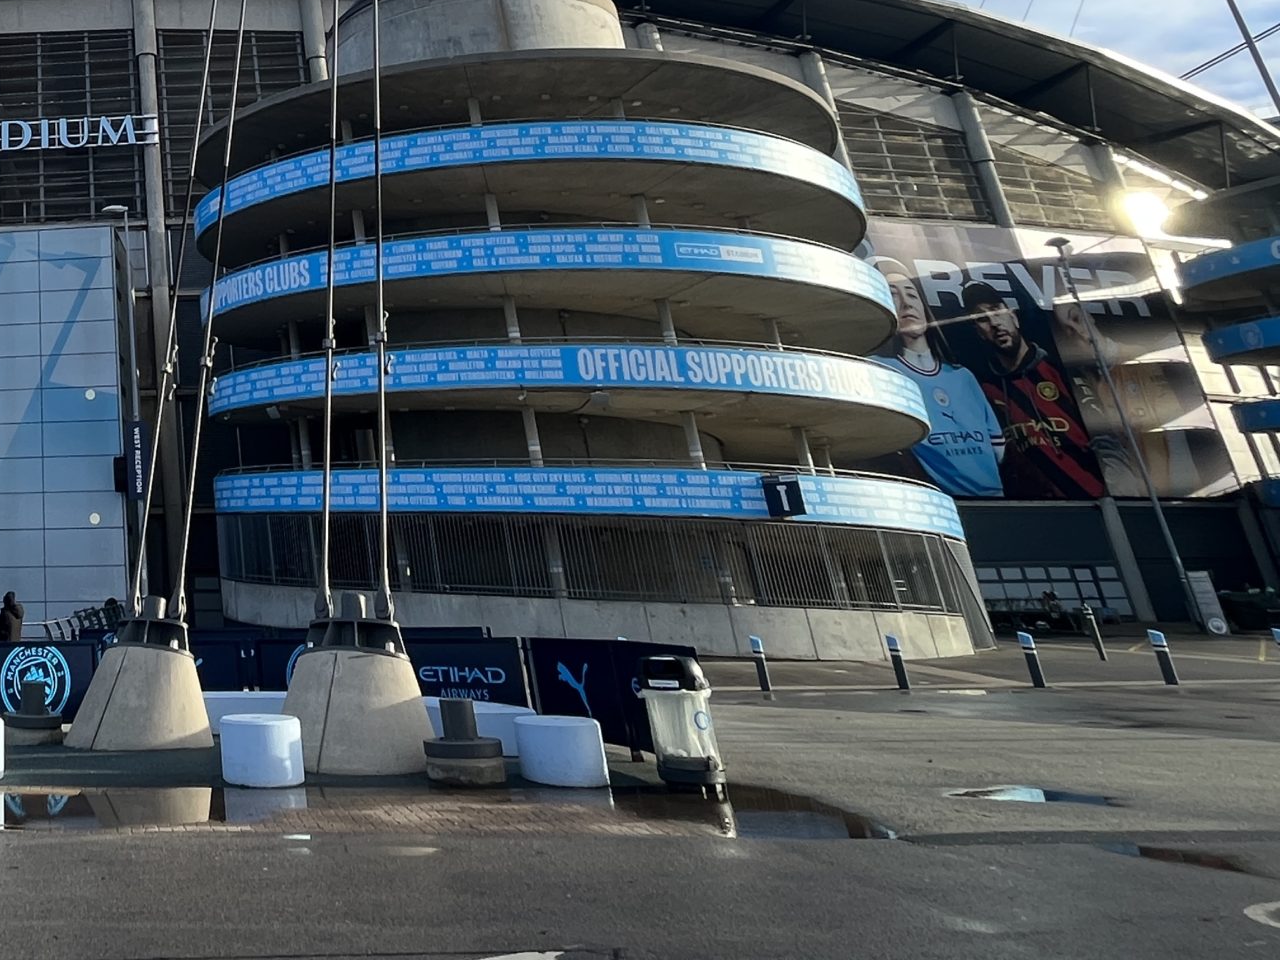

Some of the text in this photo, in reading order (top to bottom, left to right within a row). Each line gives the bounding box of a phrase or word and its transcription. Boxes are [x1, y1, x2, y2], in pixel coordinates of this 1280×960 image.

[265, 259, 311, 294] CLUBS
[870, 255, 1152, 318] REVER
[576, 347, 685, 384] OFFICIAL
[685, 351, 823, 397] SUPPORTERS
[133, 426, 141, 449] WEST
[928, 431, 984, 446] ETIHAD
[945, 446, 984, 458] AIRWAYS
[134, 449, 143, 493] RECEPTION
[6, 647, 59, 682] MANCHESTER
[419, 666, 506, 684] ETIHAD
[440, 687, 489, 700] AIRWAYS
